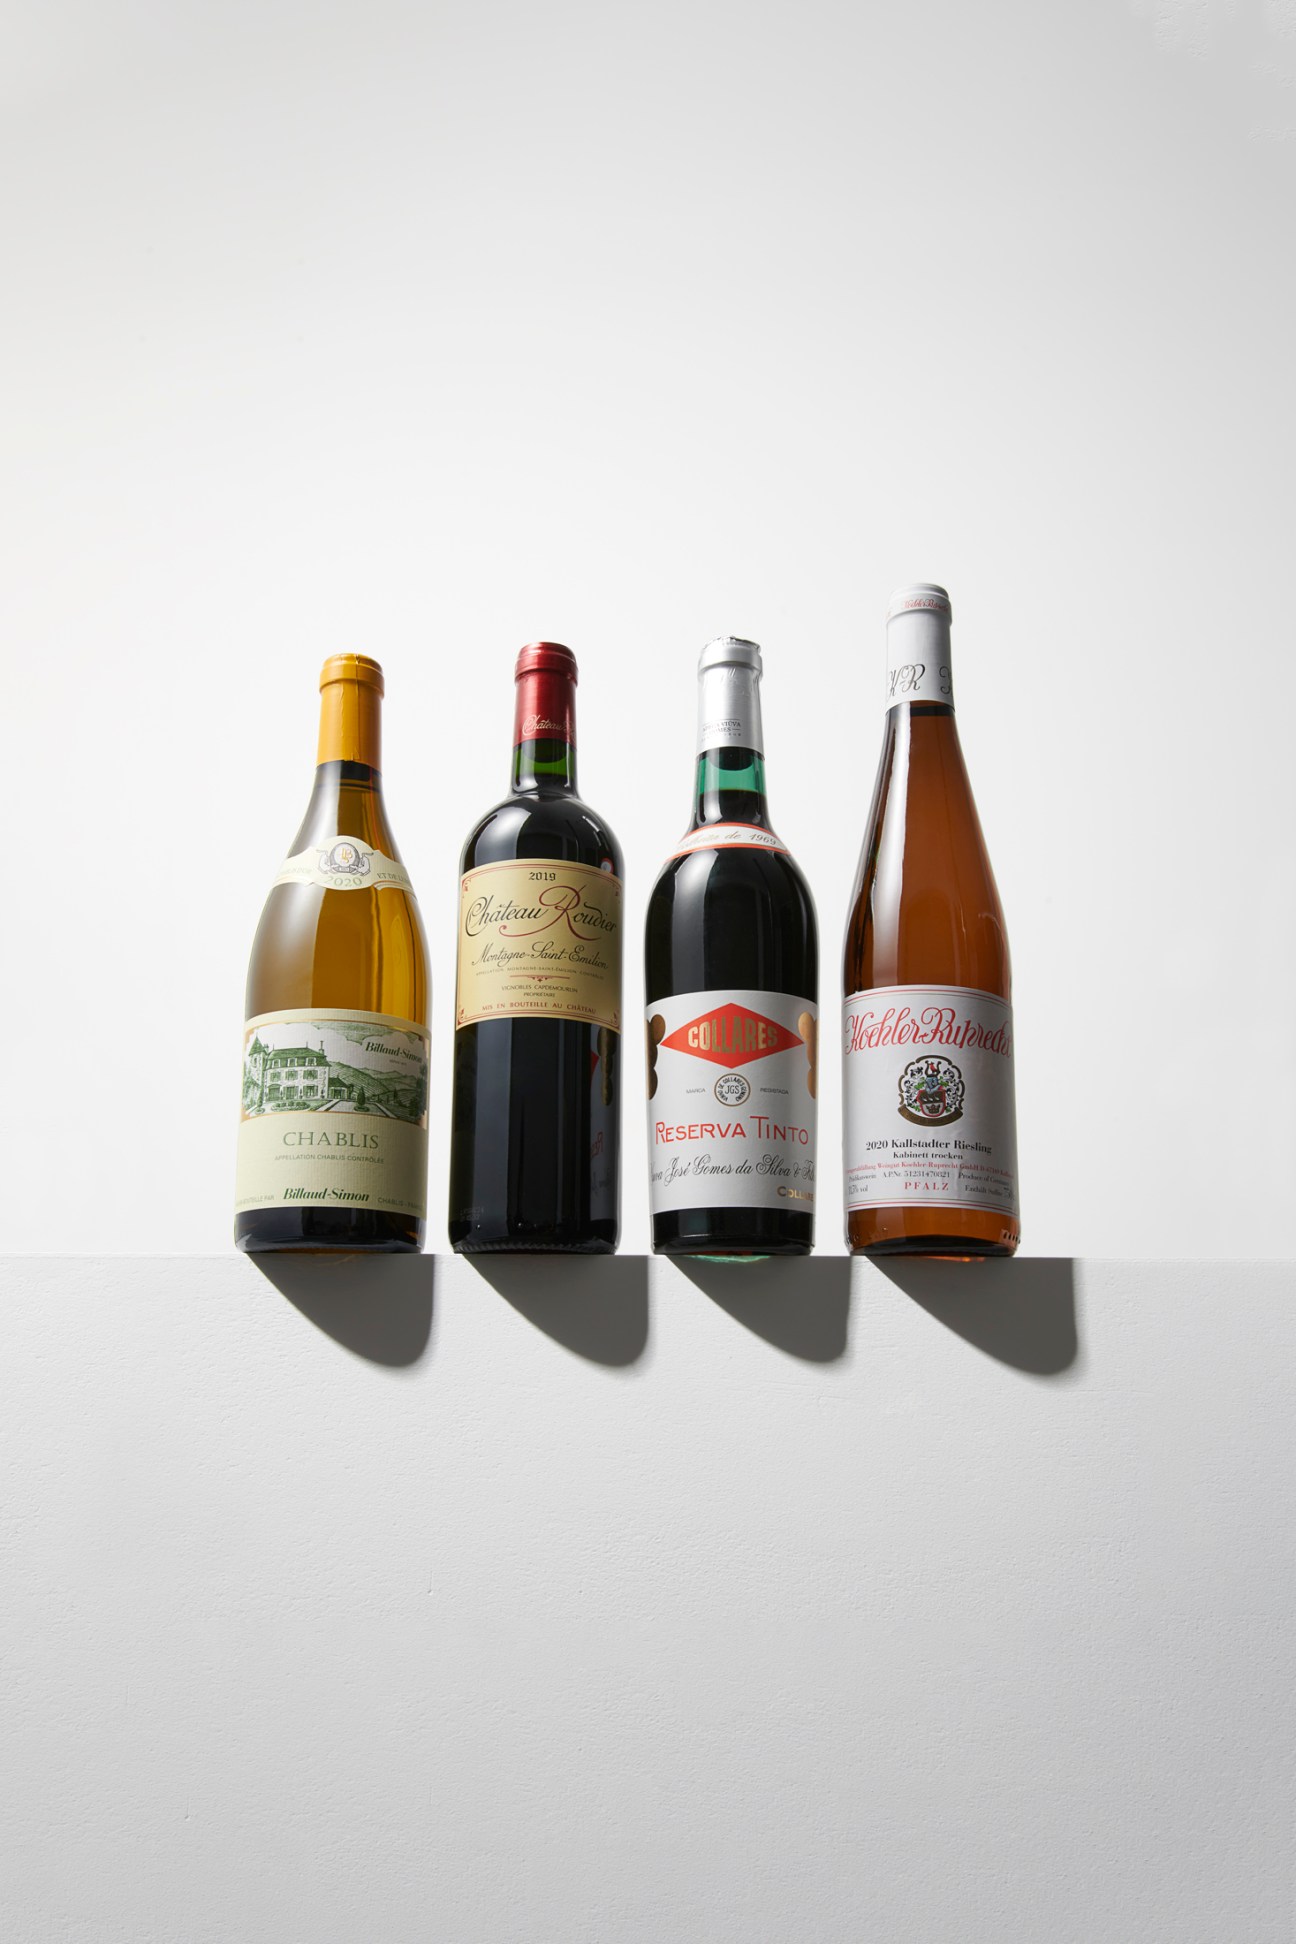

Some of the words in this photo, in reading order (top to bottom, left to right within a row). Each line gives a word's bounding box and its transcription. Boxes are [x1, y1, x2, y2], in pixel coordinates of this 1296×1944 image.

[724, 831, 742, 840] de
[324, 875, 363, 888] 2020
[528, 871, 557, 882] 2019
[509, 1001, 548, 1009] BOUTEILLE
[687, 1016, 778, 1053] COLLARES
[724, 1085, 740, 1095] JGS
[283, 1132, 379, 1149] CHABLIS
[866, 1140, 888, 1151] 2020
[891, 1138, 950, 1149] Kallstadter
[954, 1140, 992, 1154] Riesling
[893, 1151, 929, 1159] Kabinett
[692, 1154, 734, 1177] Gomes
[735, 1159, 753, 1174] da
[755, 1154, 791, 1177] Silva
[904, 1181, 949, 1191] PFALZ
[283, 1187, 370, 1202] Billaud-Simon
